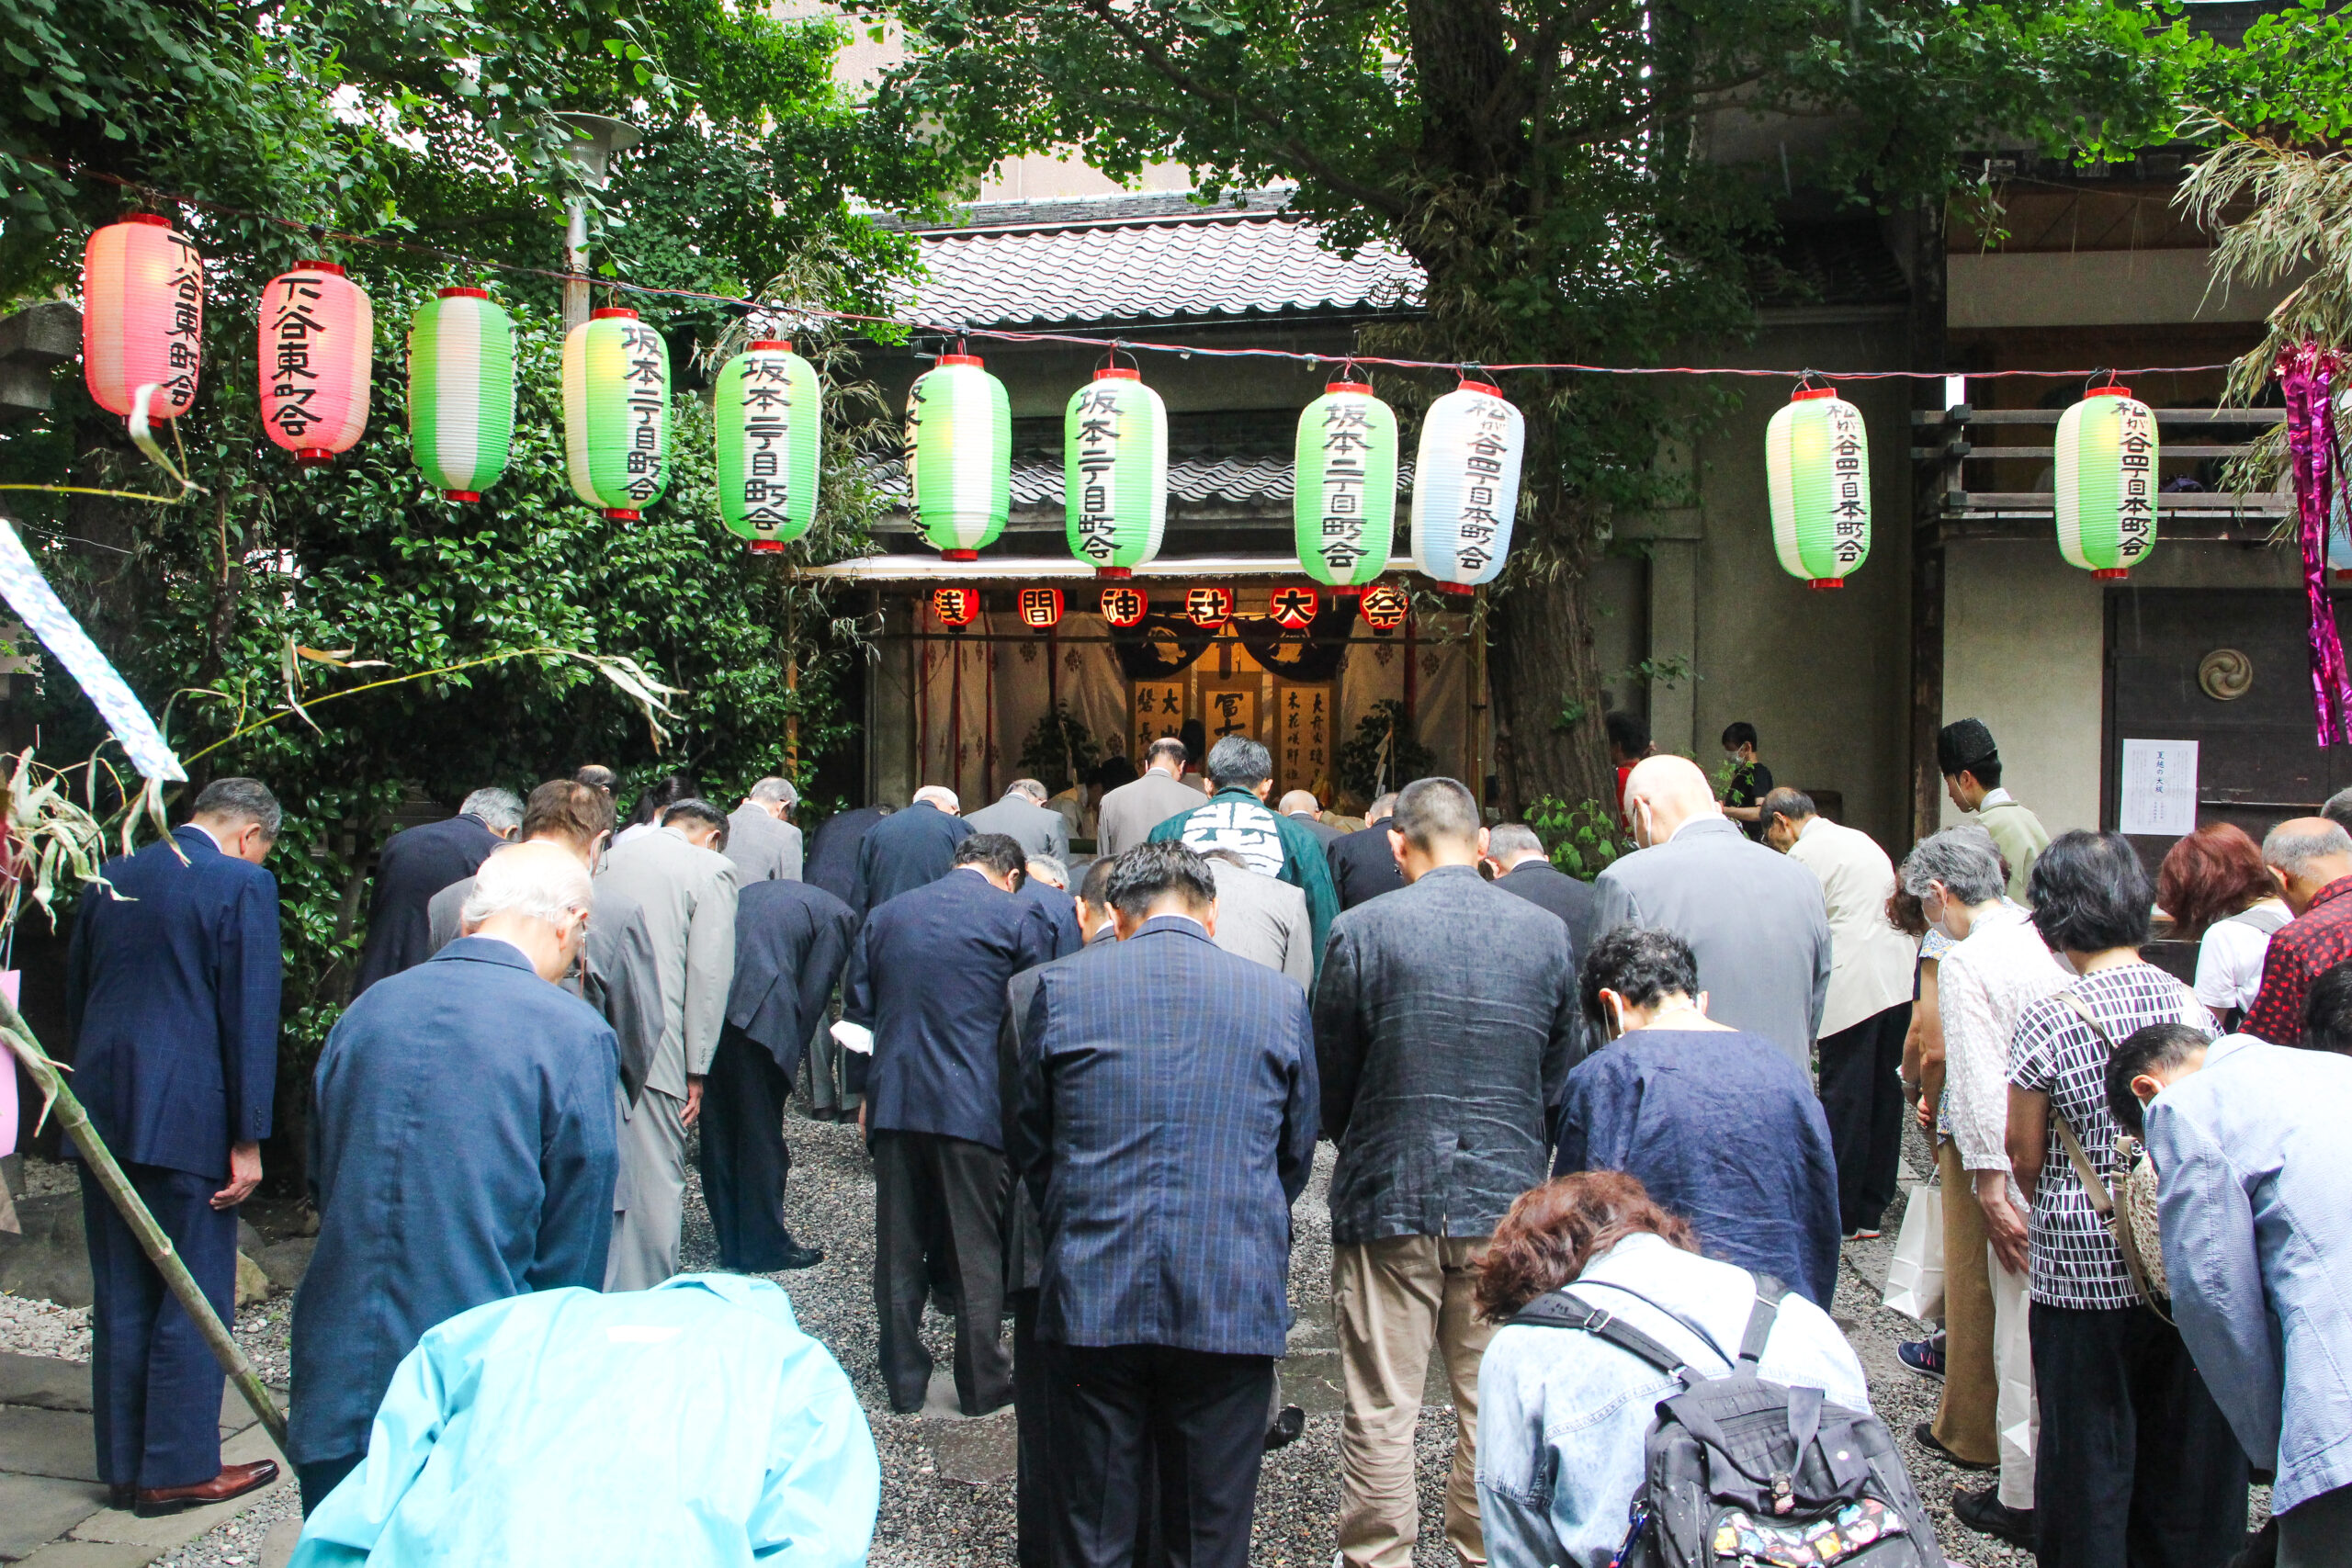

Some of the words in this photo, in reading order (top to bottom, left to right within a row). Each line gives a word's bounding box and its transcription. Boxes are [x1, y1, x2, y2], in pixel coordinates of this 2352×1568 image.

[163, 235, 202, 406] 下谷東町会
[270, 278, 325, 436] 下谷東町会
[617, 325, 664, 502] 坂本二丁目町会
[741, 358, 792, 531] 坂本二丁目町会
[1076, 389, 1124, 559] 坂本二丁目町会
[1318, 403, 1376, 569] 坂本二丁目町会
[1455, 398, 1513, 570] 松が谷四丁目本町会
[1824, 404, 1867, 562] 松が谷四丁目本町会
[2110, 401, 2153, 556] 松が谷四丁目本町会
